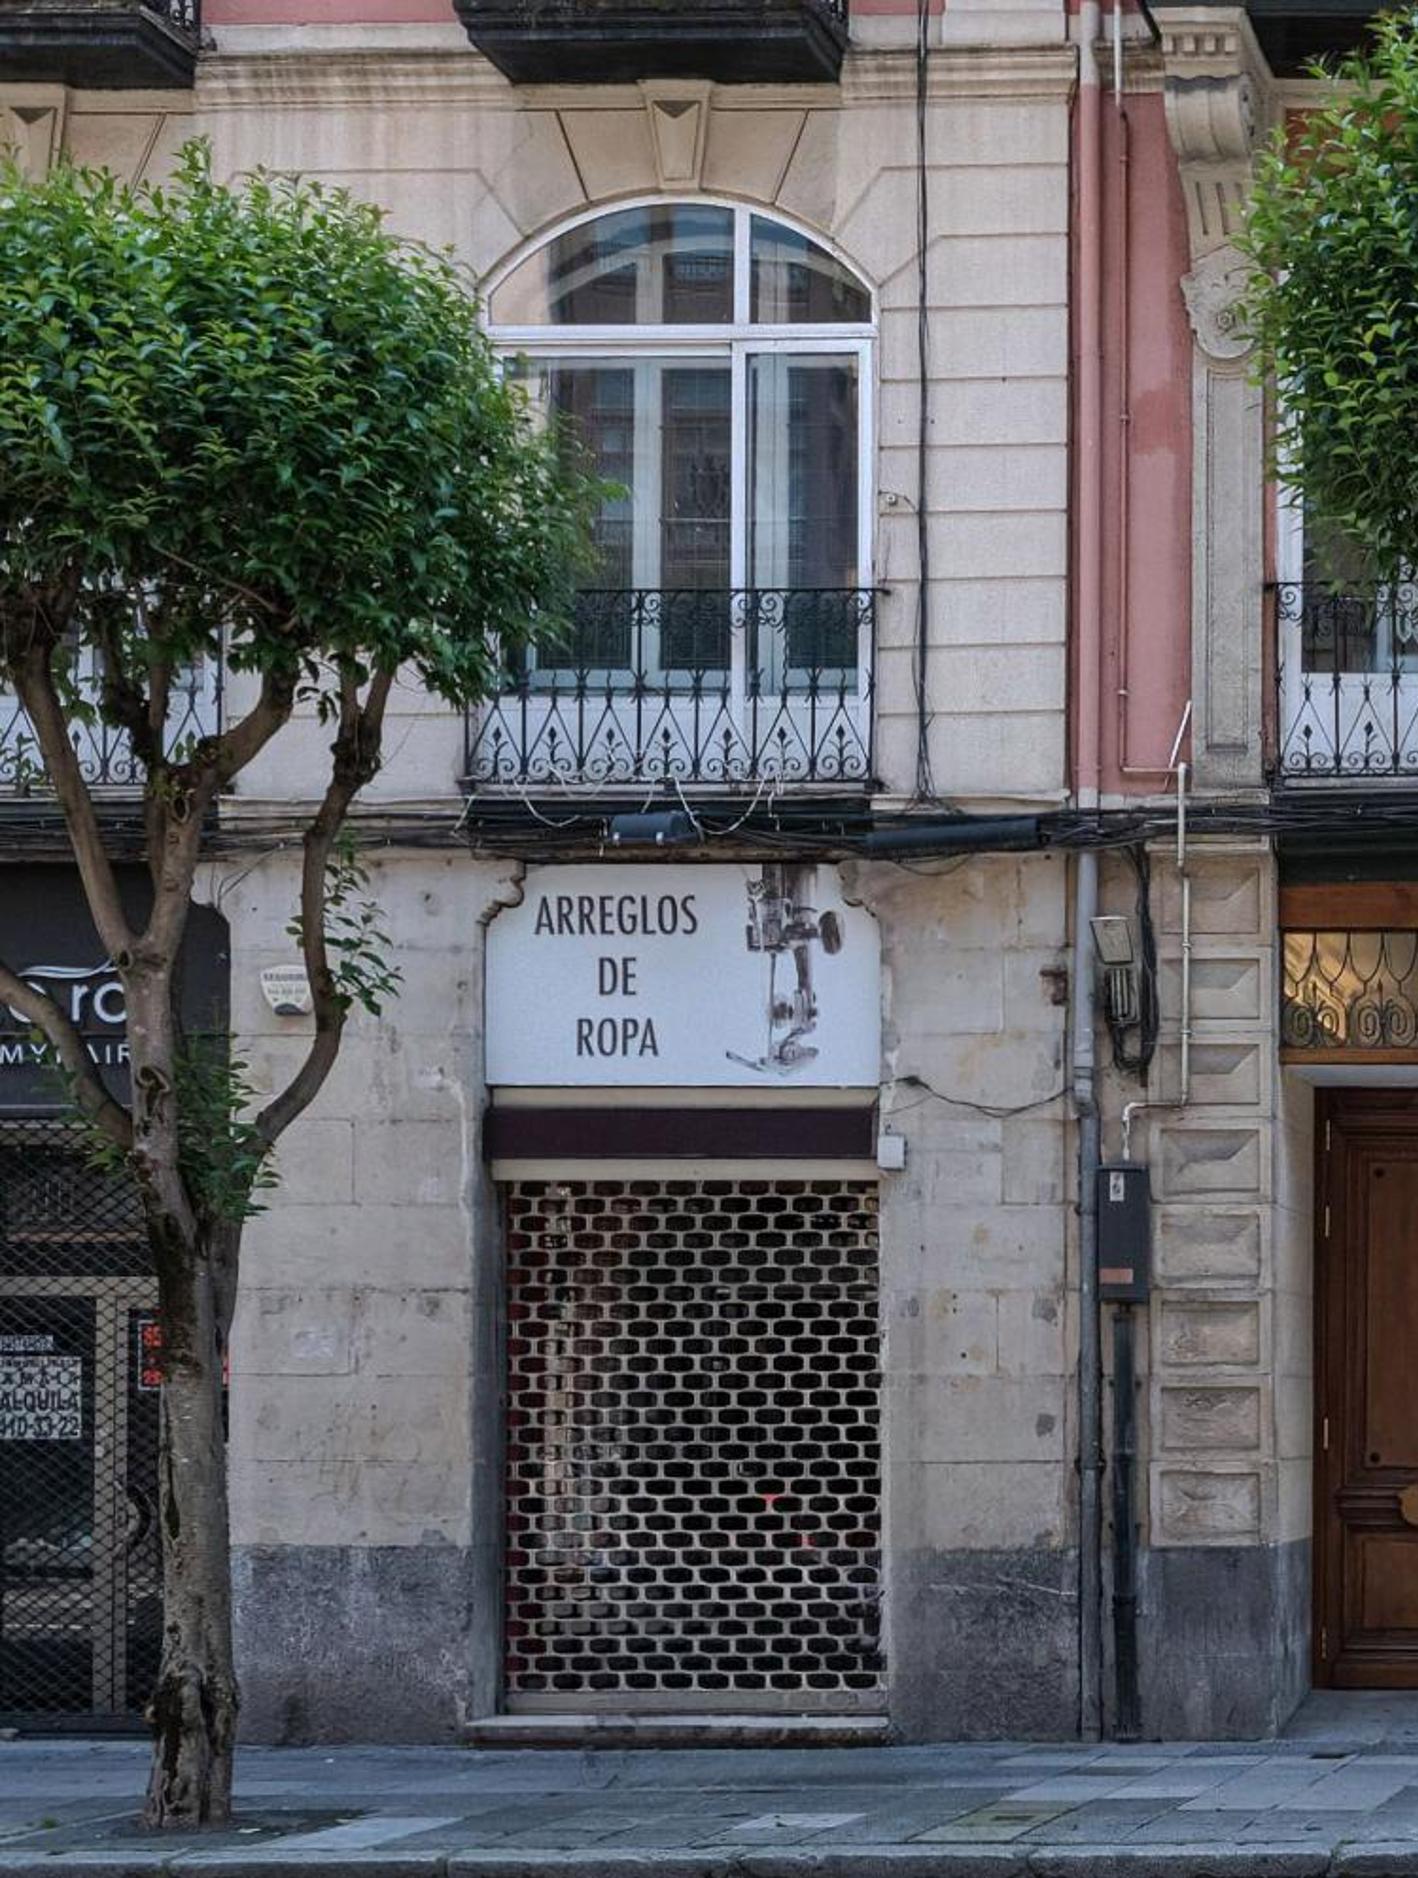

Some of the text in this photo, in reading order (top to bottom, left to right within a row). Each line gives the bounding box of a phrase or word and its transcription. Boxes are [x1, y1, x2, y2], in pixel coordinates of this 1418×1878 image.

[534, 894, 698, 936] ARREGLOS
[598, 956, 638, 997] DE
[575, 1016, 660, 1058] ROPA
